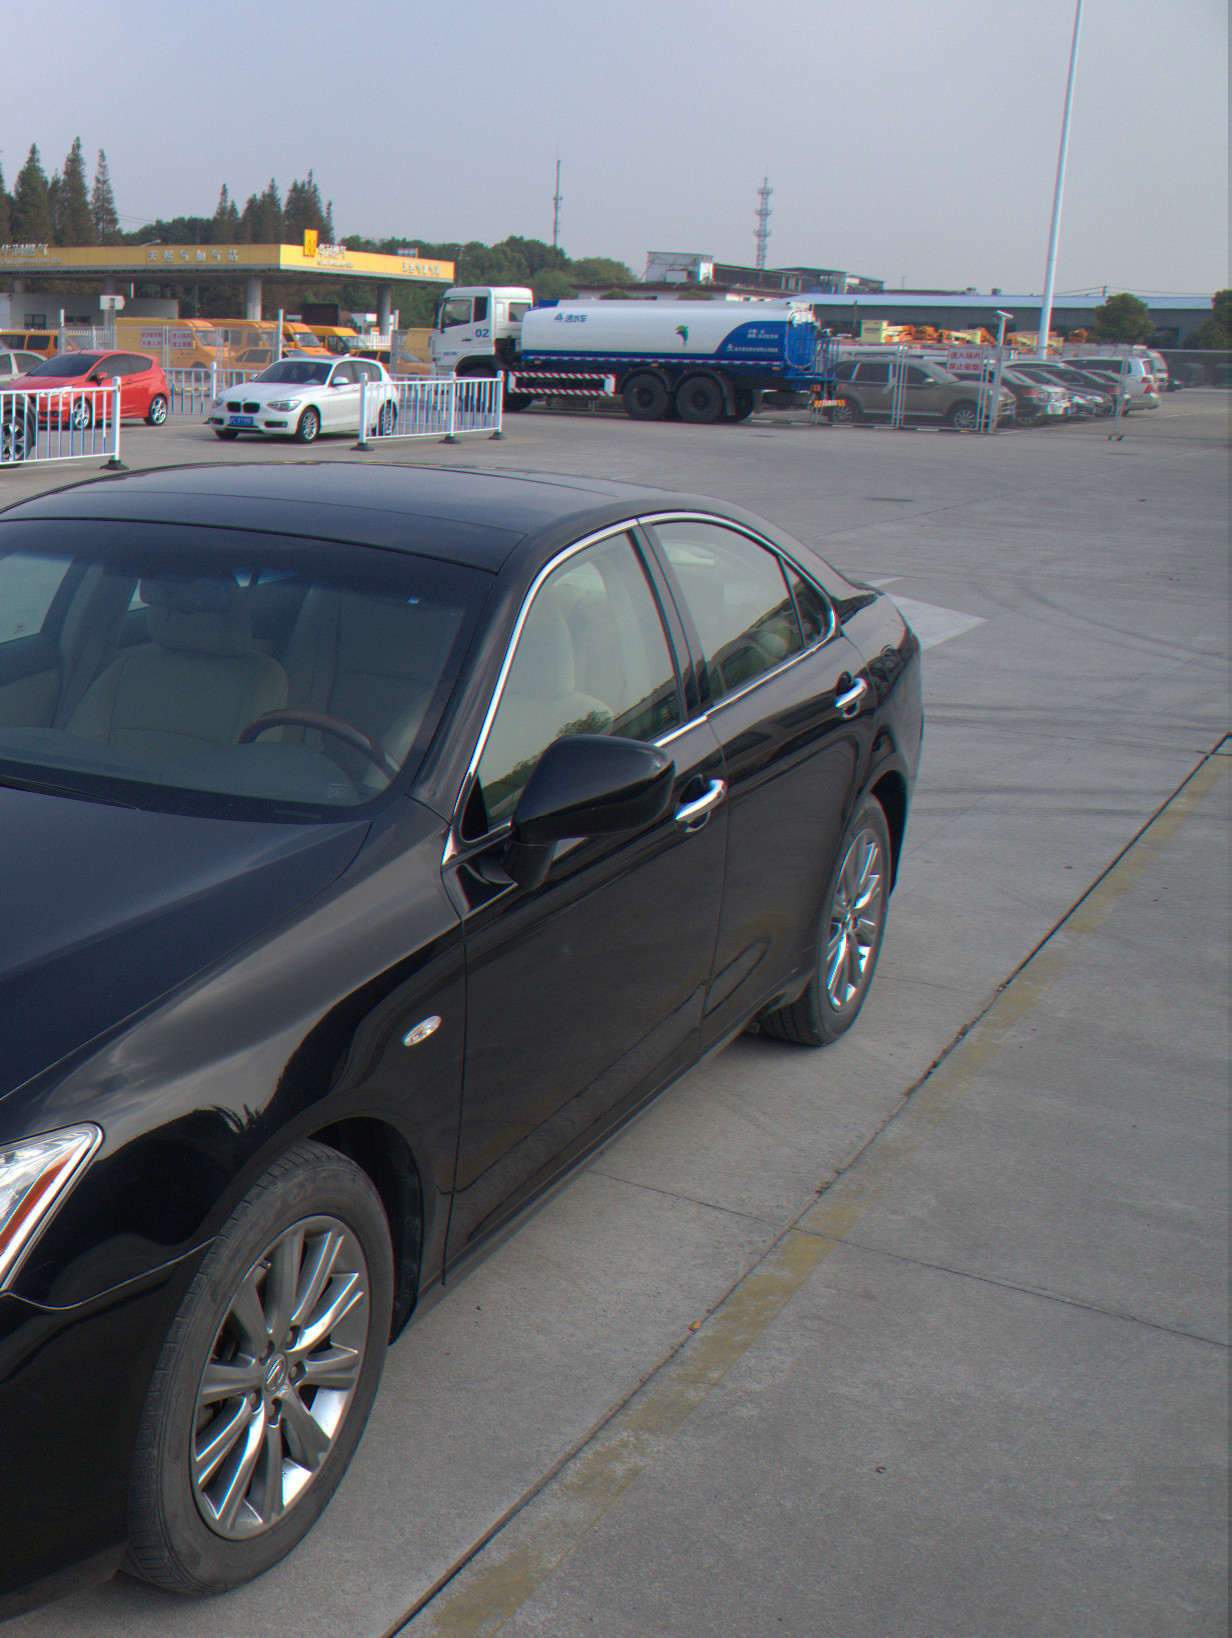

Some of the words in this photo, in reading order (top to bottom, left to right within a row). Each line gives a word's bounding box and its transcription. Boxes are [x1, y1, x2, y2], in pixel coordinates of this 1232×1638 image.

[0, 243, 49, 257] 华润燃气
[147, 248, 239, 262] 天然气加气站
[50, 256, 63, 264] Gas
[474, 328, 490, 338] 02
[950, 351, 981, 360] 进入场内
[948, 362, 980, 372] 禁止吸烟
